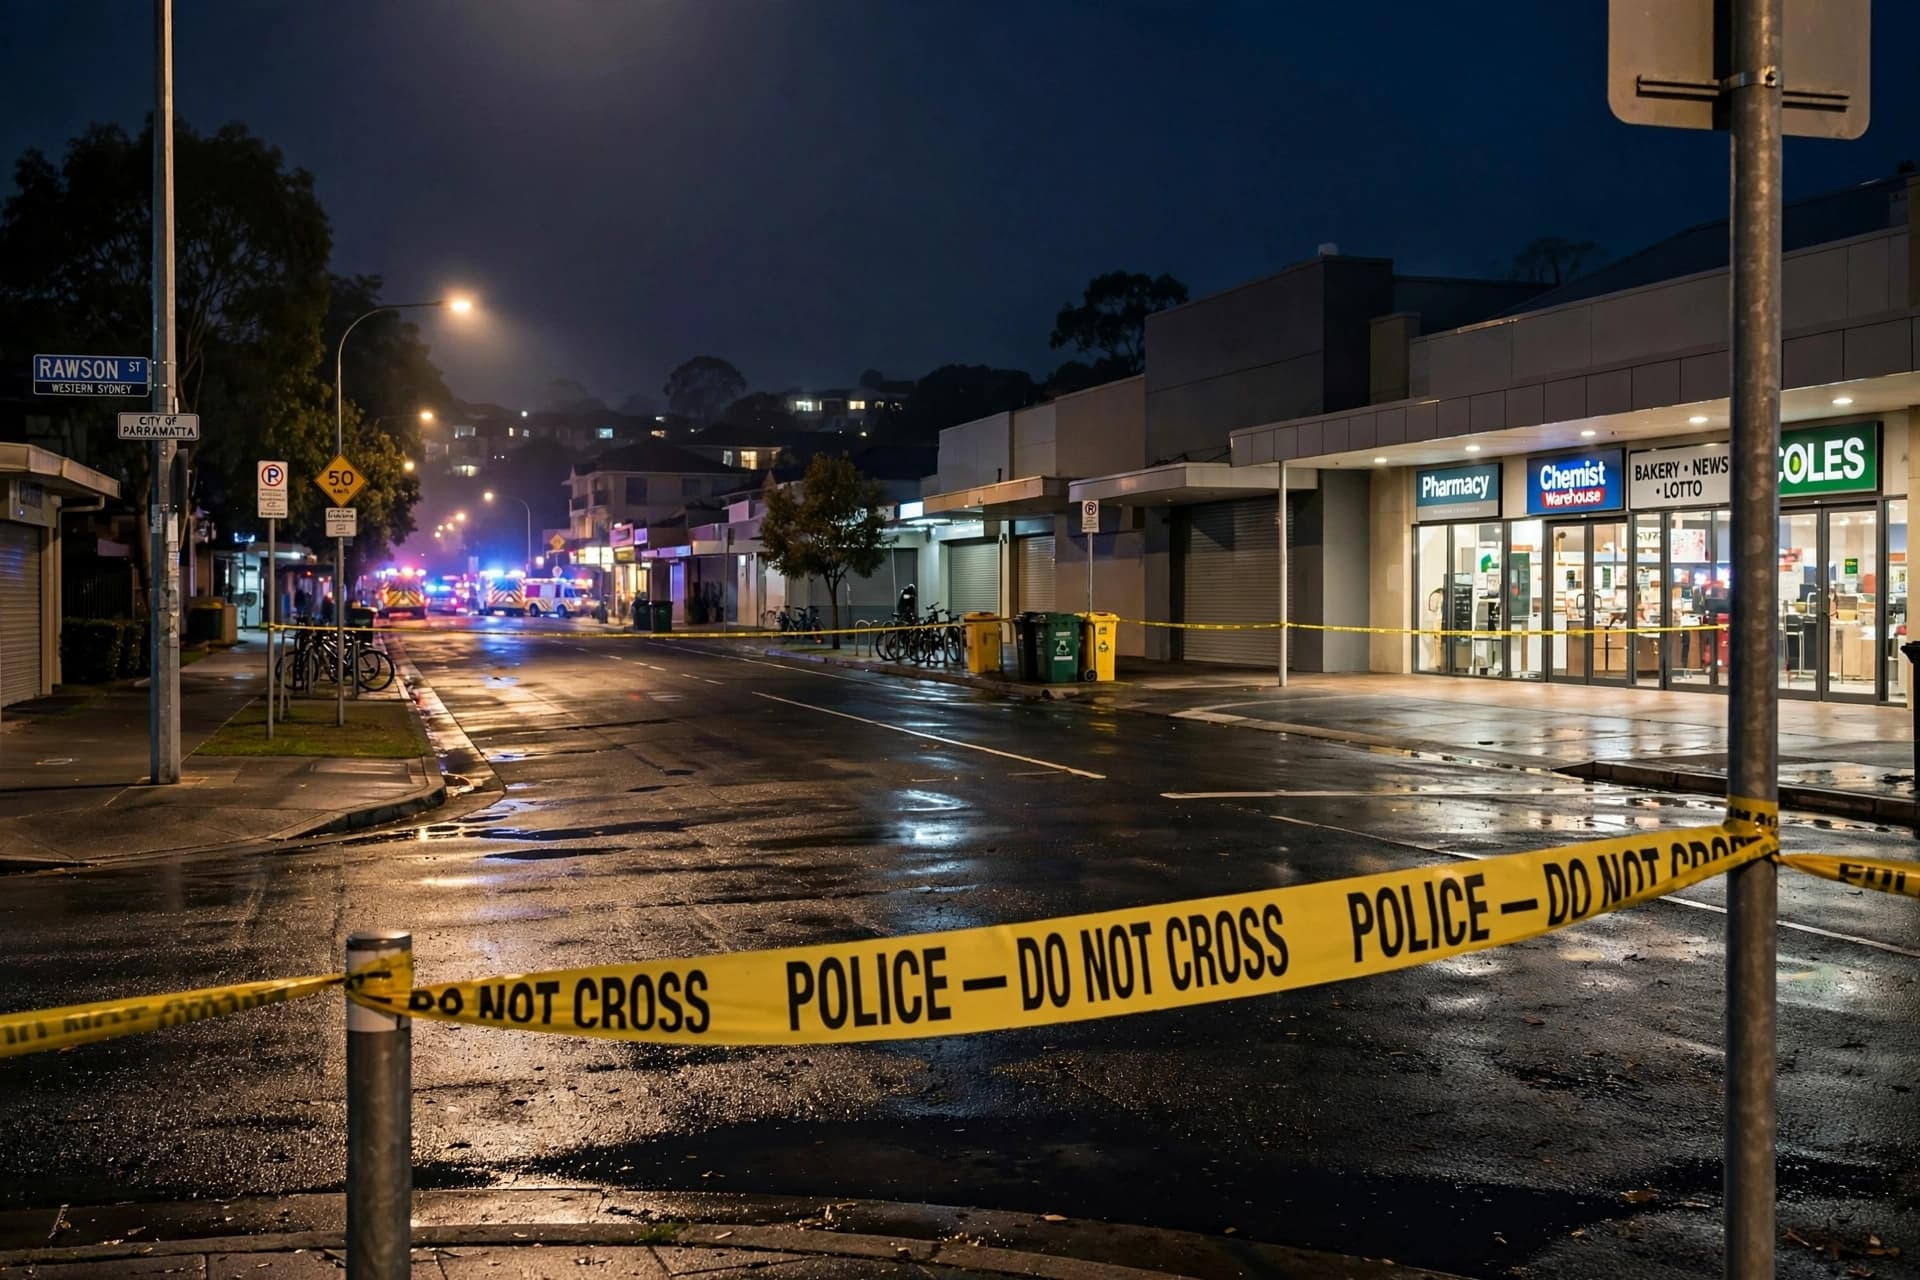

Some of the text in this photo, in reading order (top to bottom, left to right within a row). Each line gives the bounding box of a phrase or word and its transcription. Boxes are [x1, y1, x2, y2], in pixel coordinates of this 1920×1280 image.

[39, 358, 141, 380] RAWSON ST
[52, 383, 132, 394] WESTERN SYDNEY
[123, 425, 195, 437] PARRAMATTA
[139, 416, 177, 427] CITY OF
[1635, 456, 1729, 481] BAKERY NEWS
[1778, 437, 1865, 485] OLES
[328, 470, 354, 486] 50
[1540, 460, 1606, 490] Chemist
[1422, 475, 1490, 499] Pharmacy
[1664, 480, 1703, 499] LOTTO
[1545, 488, 1601, 507] Warehouse
[479, 980, 560, 1025] NOT
[574, 969, 710, 1034] CROSS
[786, 947, 952, 1031] POLICE
[1017, 931, 1071, 1012] DO
[1081, 921, 1153, 1003] NOT
[1165, 903, 1290, 992] CROSS
[1347, 873, 1490, 964] POLICE
[1542, 857, 1592, 927] DO
[1599, 847, 1660, 907] NOT
